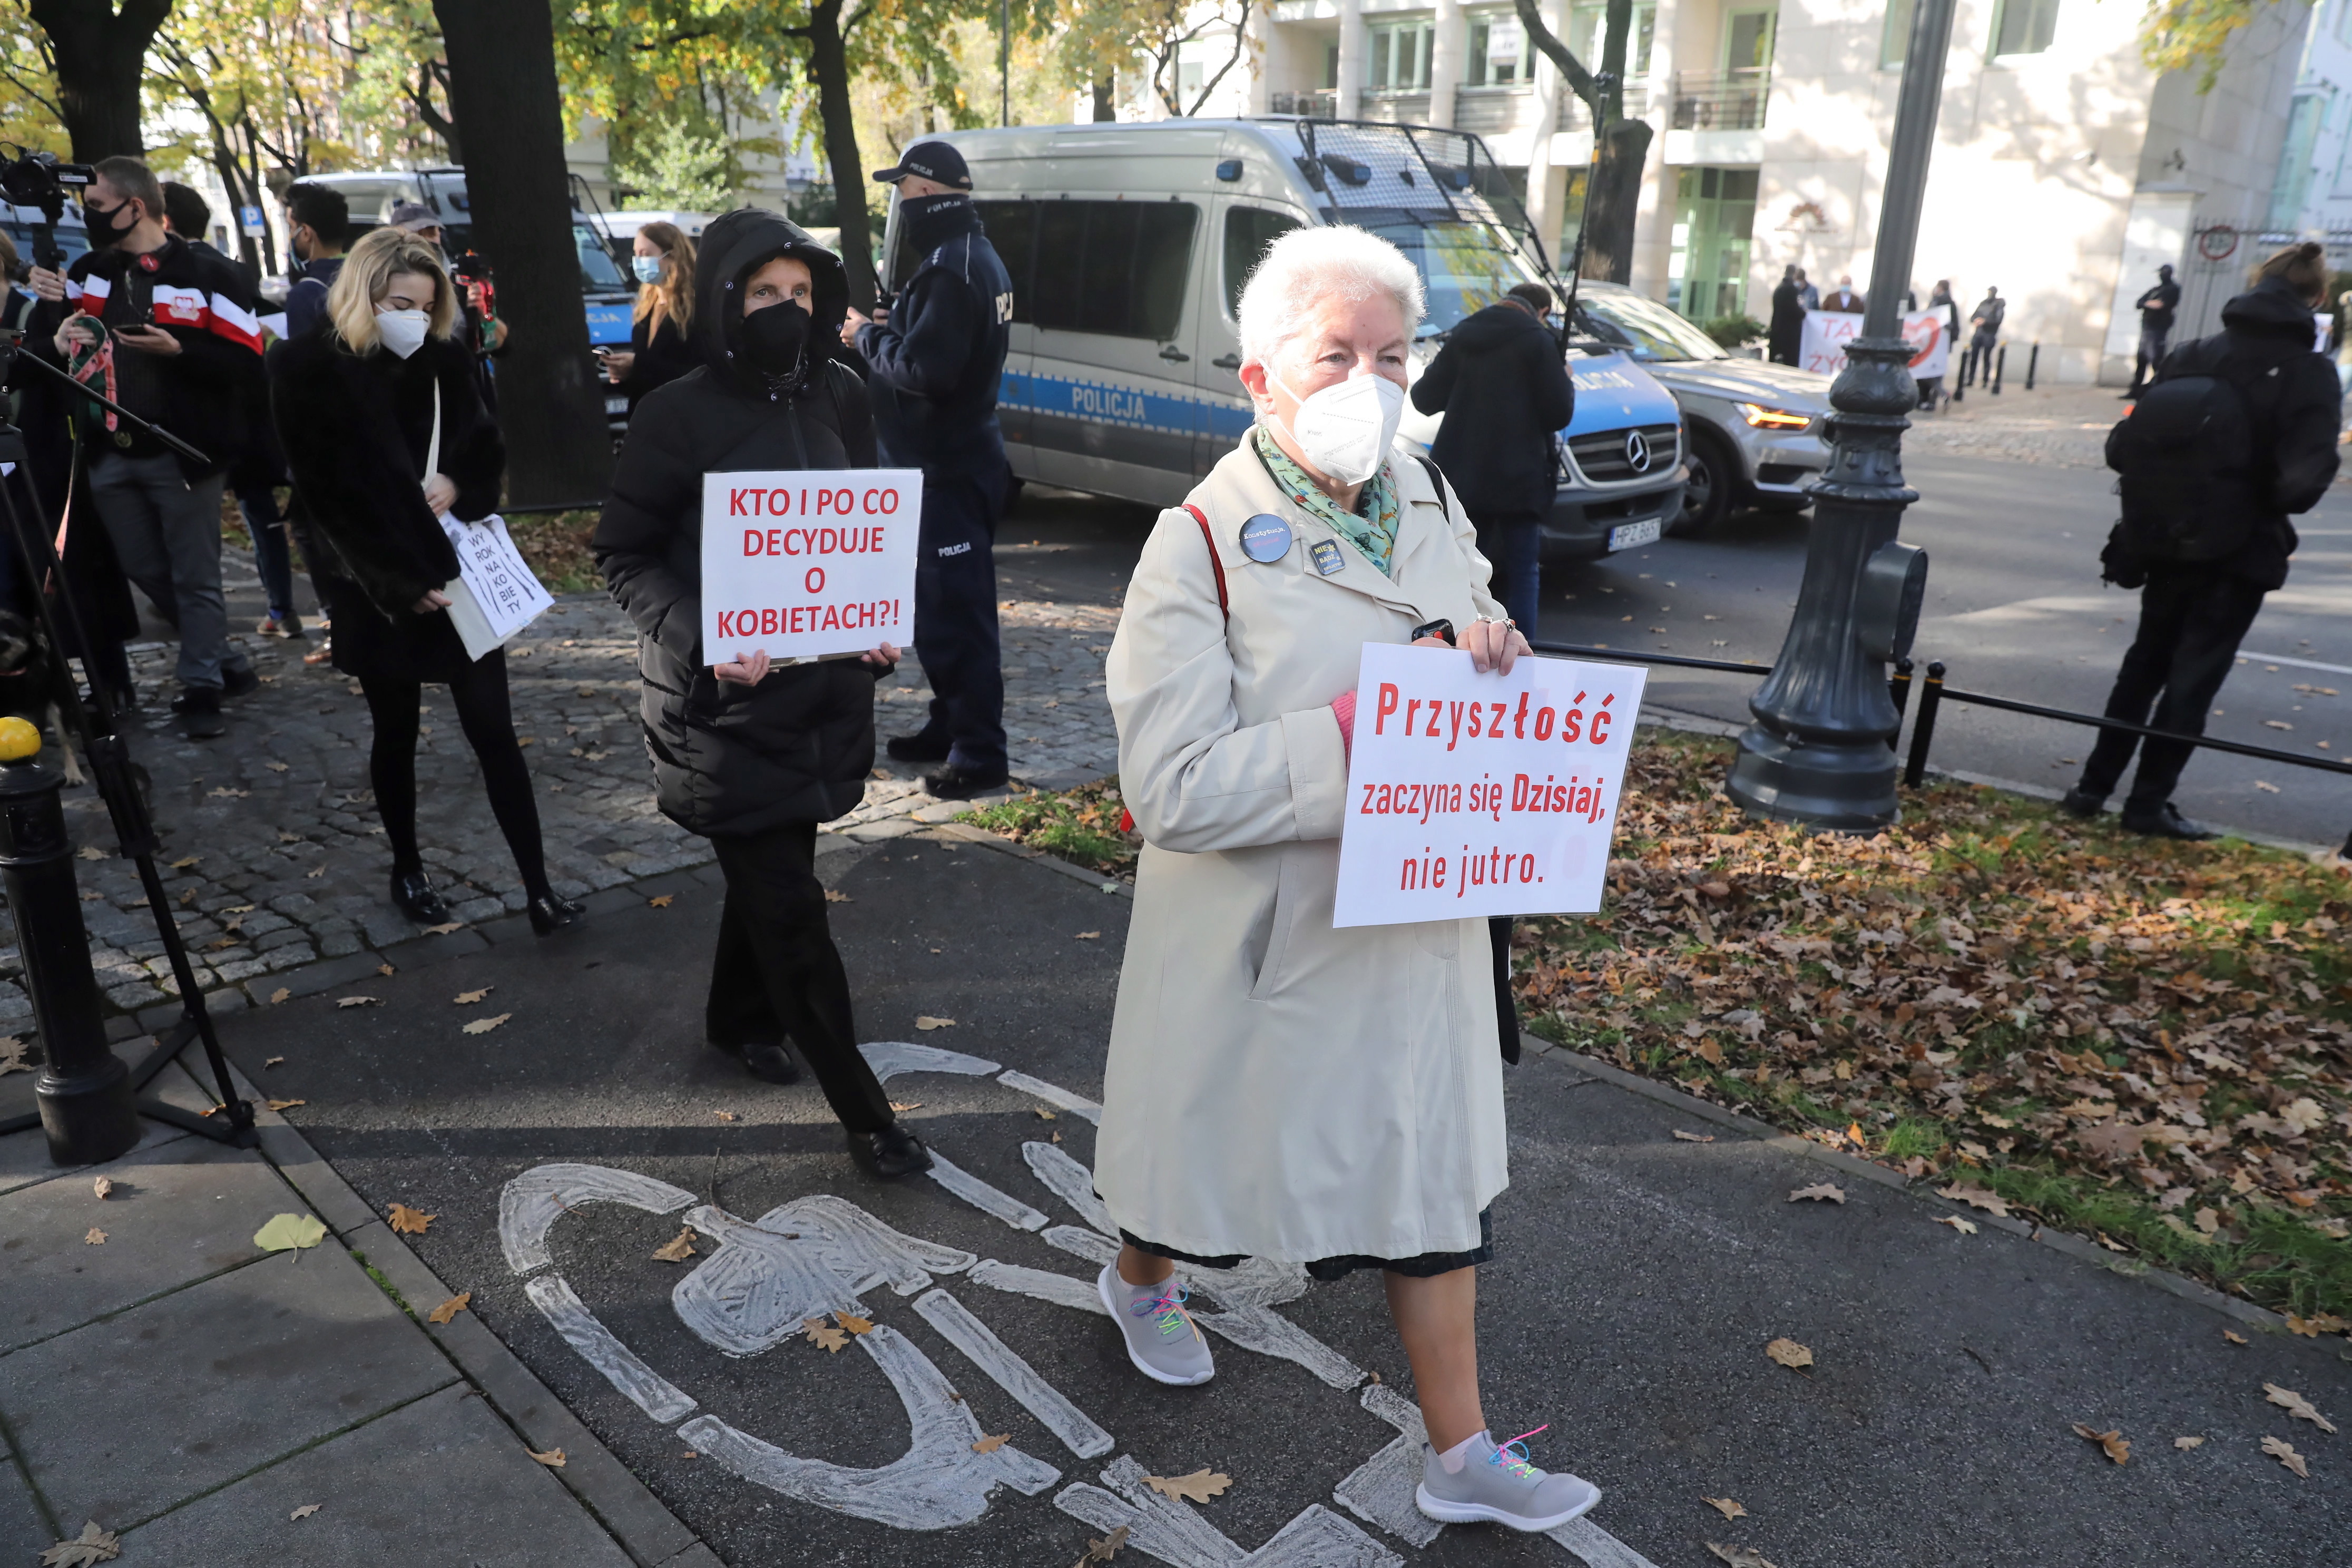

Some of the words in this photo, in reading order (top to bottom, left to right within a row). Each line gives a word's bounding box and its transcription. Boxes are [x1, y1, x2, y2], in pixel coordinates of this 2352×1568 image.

[1822, 318, 1855, 339] TA
[1072, 387, 1146, 420] POLICJA
[730, 488, 790, 516] KTO
[800, 489, 807, 515] I
[817, 488, 854, 515] PO
[863, 488, 899, 515] CO
[468, 532, 485, 547] WY
[743, 527, 885, 556] DECYDUJE
[1243, 527, 1286, 540] Konstytucja.
[475, 545, 495, 563] ROK
[938, 542, 972, 557] POLICJA
[1314, 545, 1328, 554] NIE
[484, 561, 501, 575] NA
[492, 574, 508, 589] KO
[805, 567, 826, 594] O
[499, 586, 517, 602] BIE
[507, 600, 521, 614] TY
[718, 599, 899, 638] KOBIETACH?!
[1375, 682, 1615, 751] Przyszłość
[1361, 783, 1462, 825] zaczyna
[1469, 773, 1502, 822] się
[1511, 773, 1605, 824] Dzisiaj,
[1400, 846, 1446, 890] nie
[1457, 844, 1544, 898] jutro.
